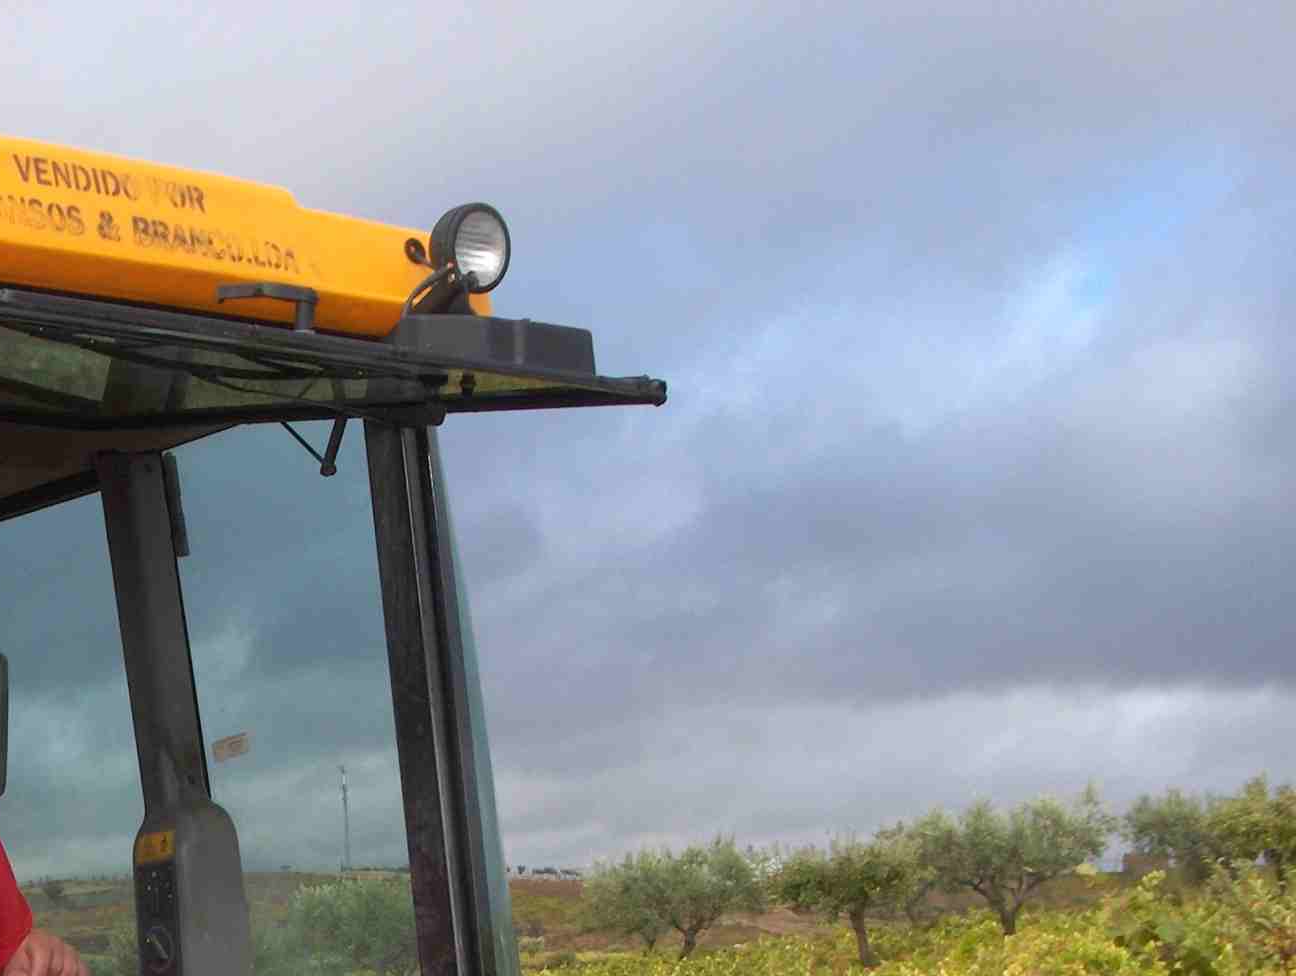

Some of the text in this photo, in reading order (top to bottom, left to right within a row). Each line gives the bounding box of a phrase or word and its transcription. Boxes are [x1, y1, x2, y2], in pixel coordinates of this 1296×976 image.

[12, 152, 207, 214] VENDIDO OR
[97, 208, 122, 242] &
